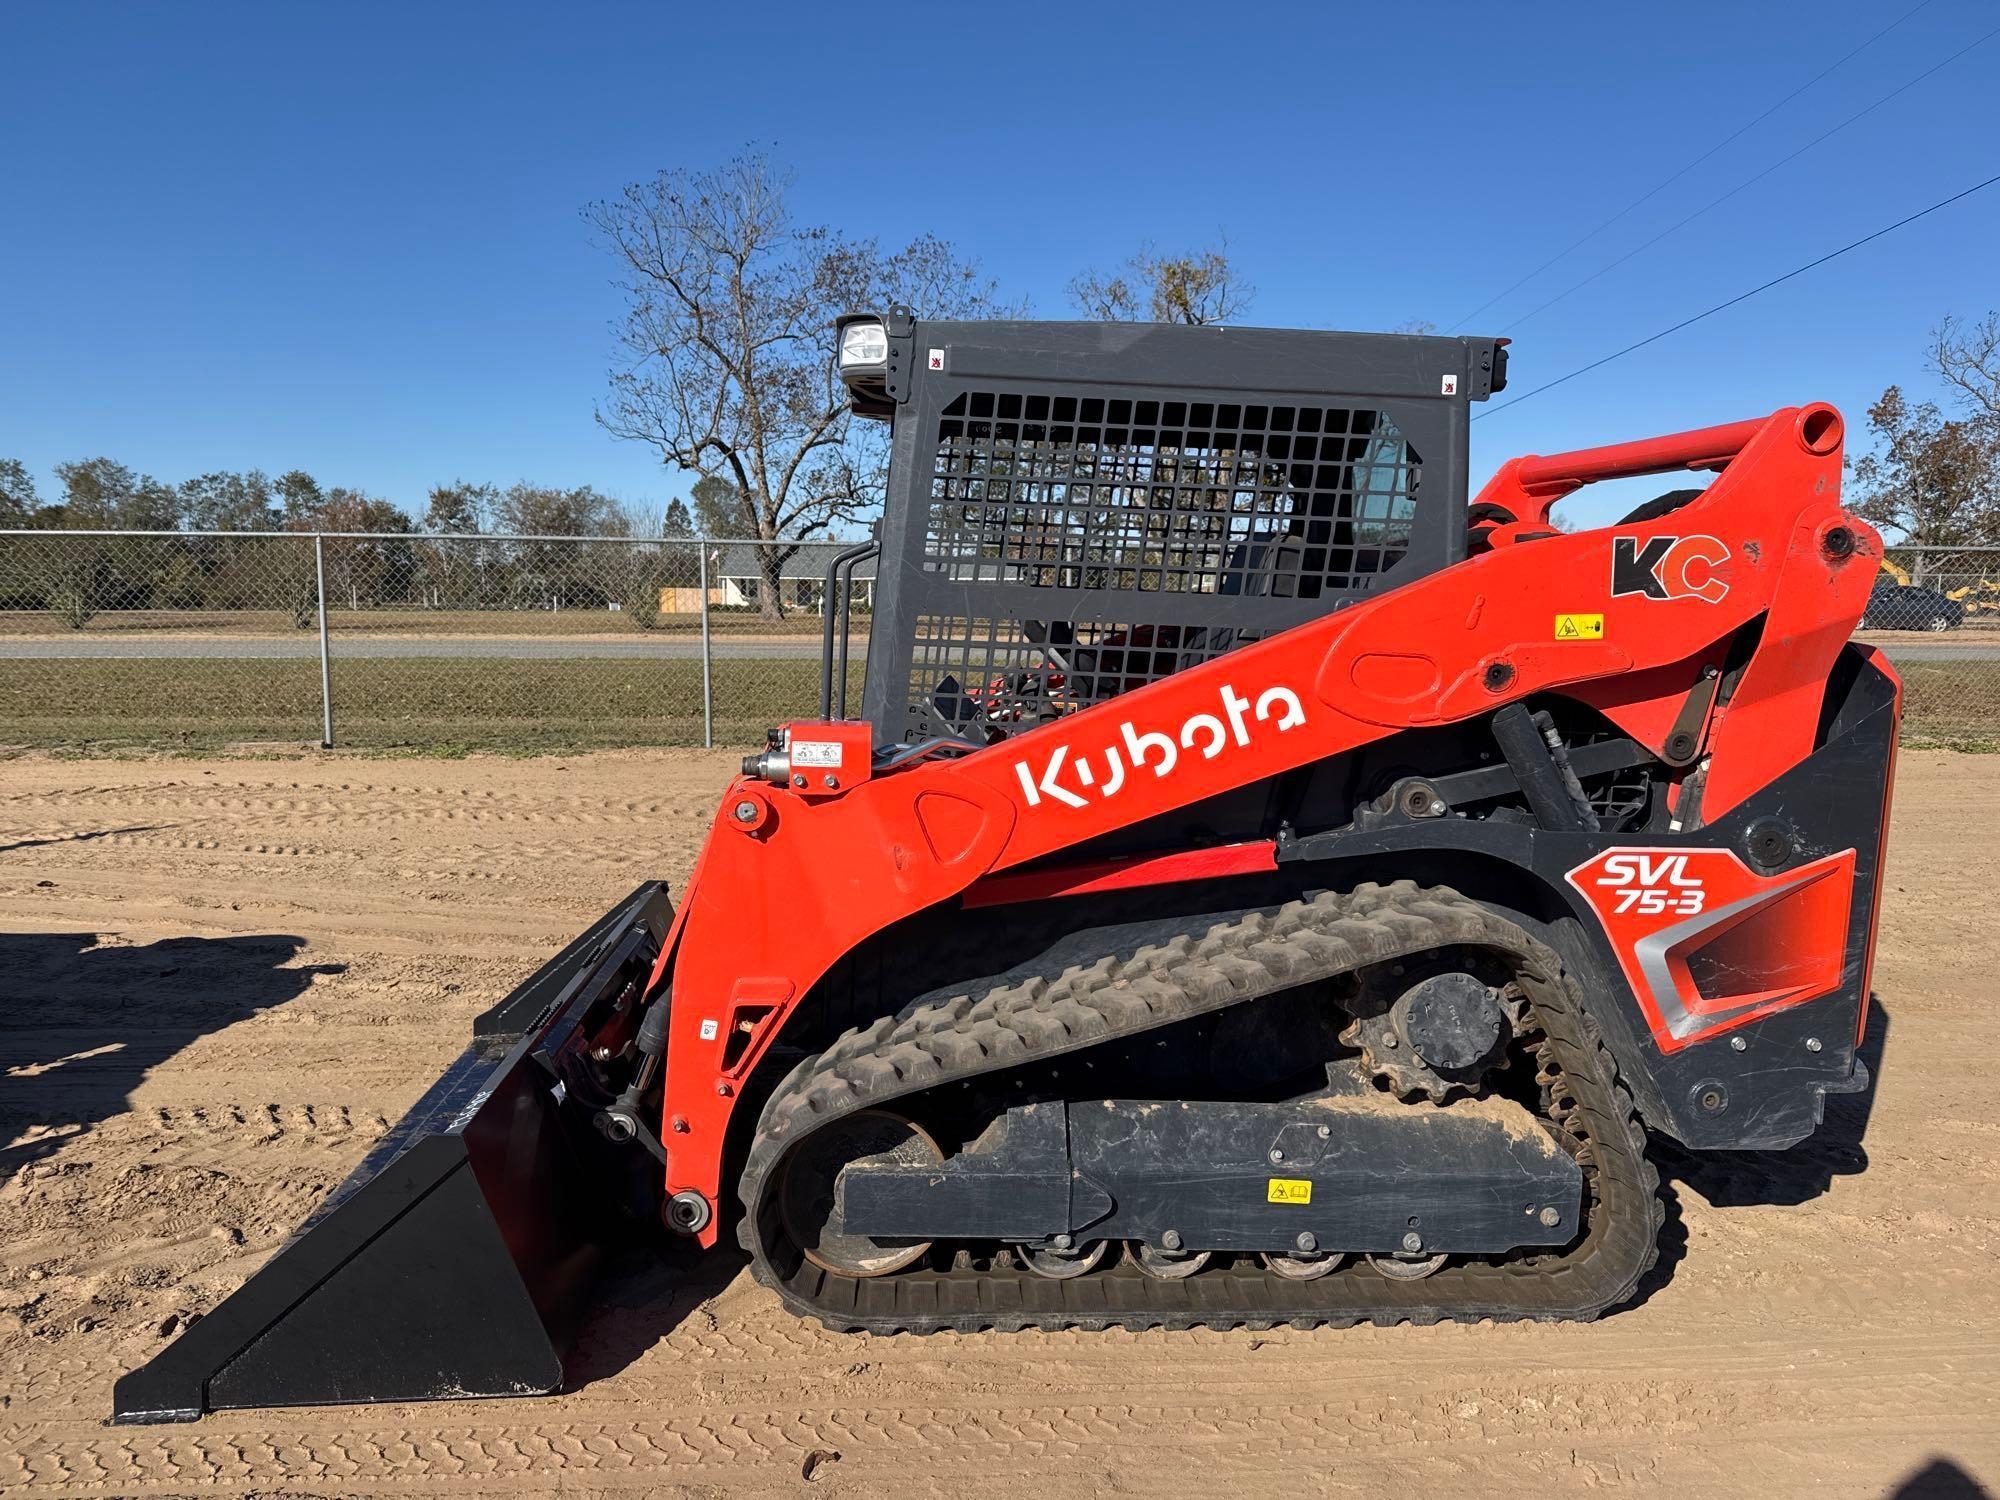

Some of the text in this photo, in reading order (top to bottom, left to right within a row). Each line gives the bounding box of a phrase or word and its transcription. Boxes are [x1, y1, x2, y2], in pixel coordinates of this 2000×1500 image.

[1611, 535, 1732, 604] KC
[1015, 684, 1306, 808] Kubota
[1596, 855, 1703, 886] SVL
[1613, 889, 1706, 915] 75-3
